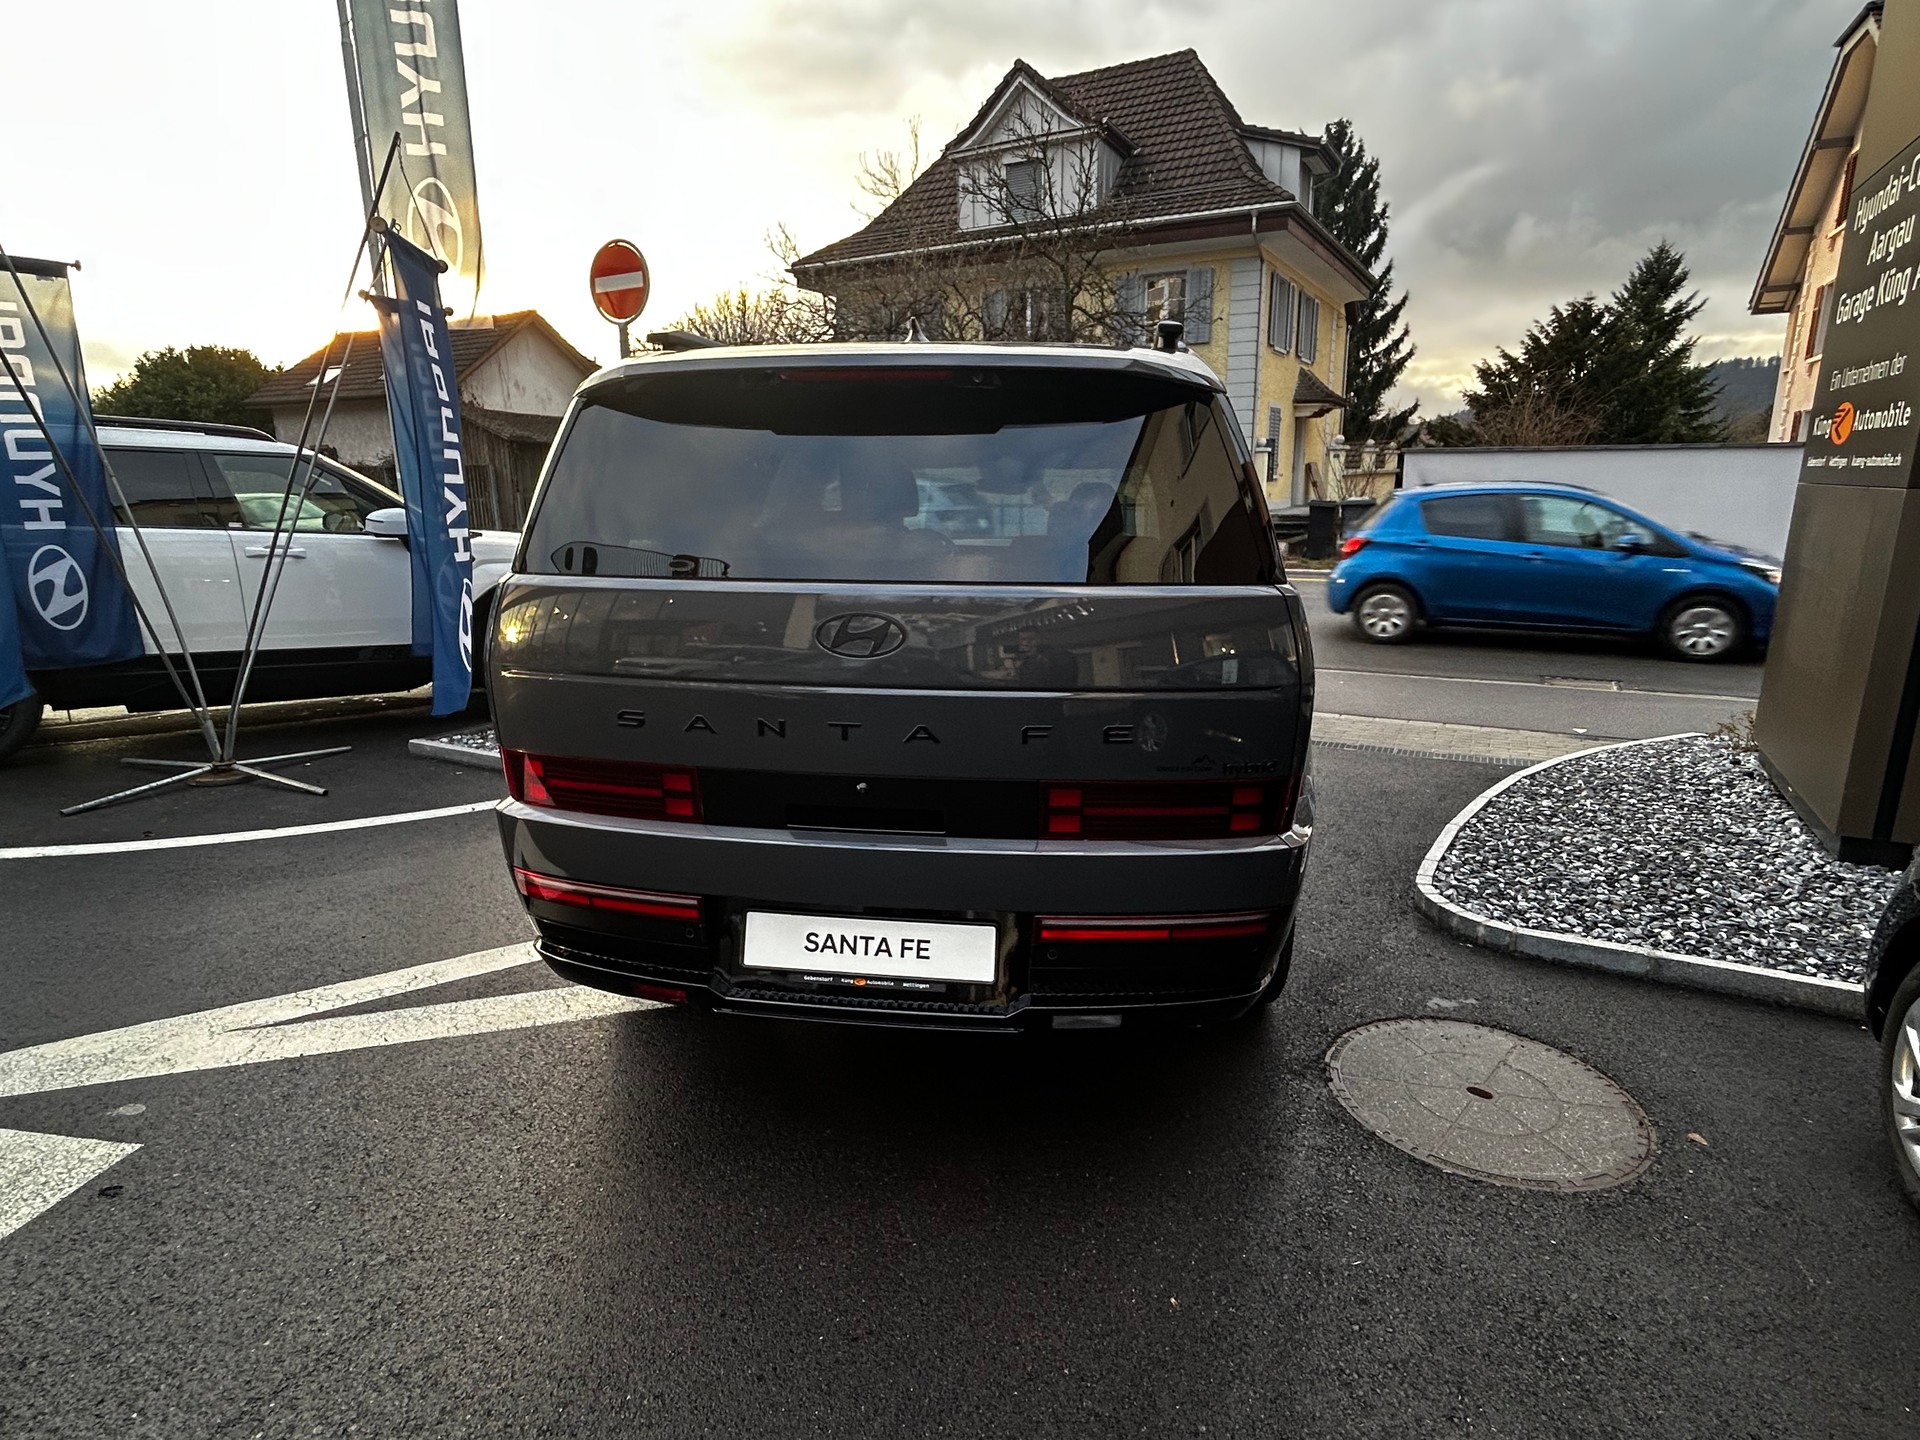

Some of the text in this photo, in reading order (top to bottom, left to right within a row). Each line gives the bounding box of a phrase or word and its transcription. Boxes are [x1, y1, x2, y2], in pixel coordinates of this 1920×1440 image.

[390, 0, 446, 157] HYU
[1866, 214, 1916, 266] Aargau
[1835, 285, 1875, 325] Garage
[1875, 267, 1913, 306] Küng
[1841, 360, 1890, 389] Unternehmen
[1889, 352, 1908, 376] der
[416, 299, 471, 562] HYUNDAI
[1812, 401, 1911, 439] Küng Automobile
[616, 708, 1135, 745] SANTA FE
[804, 931, 931, 960] SANTA FE
